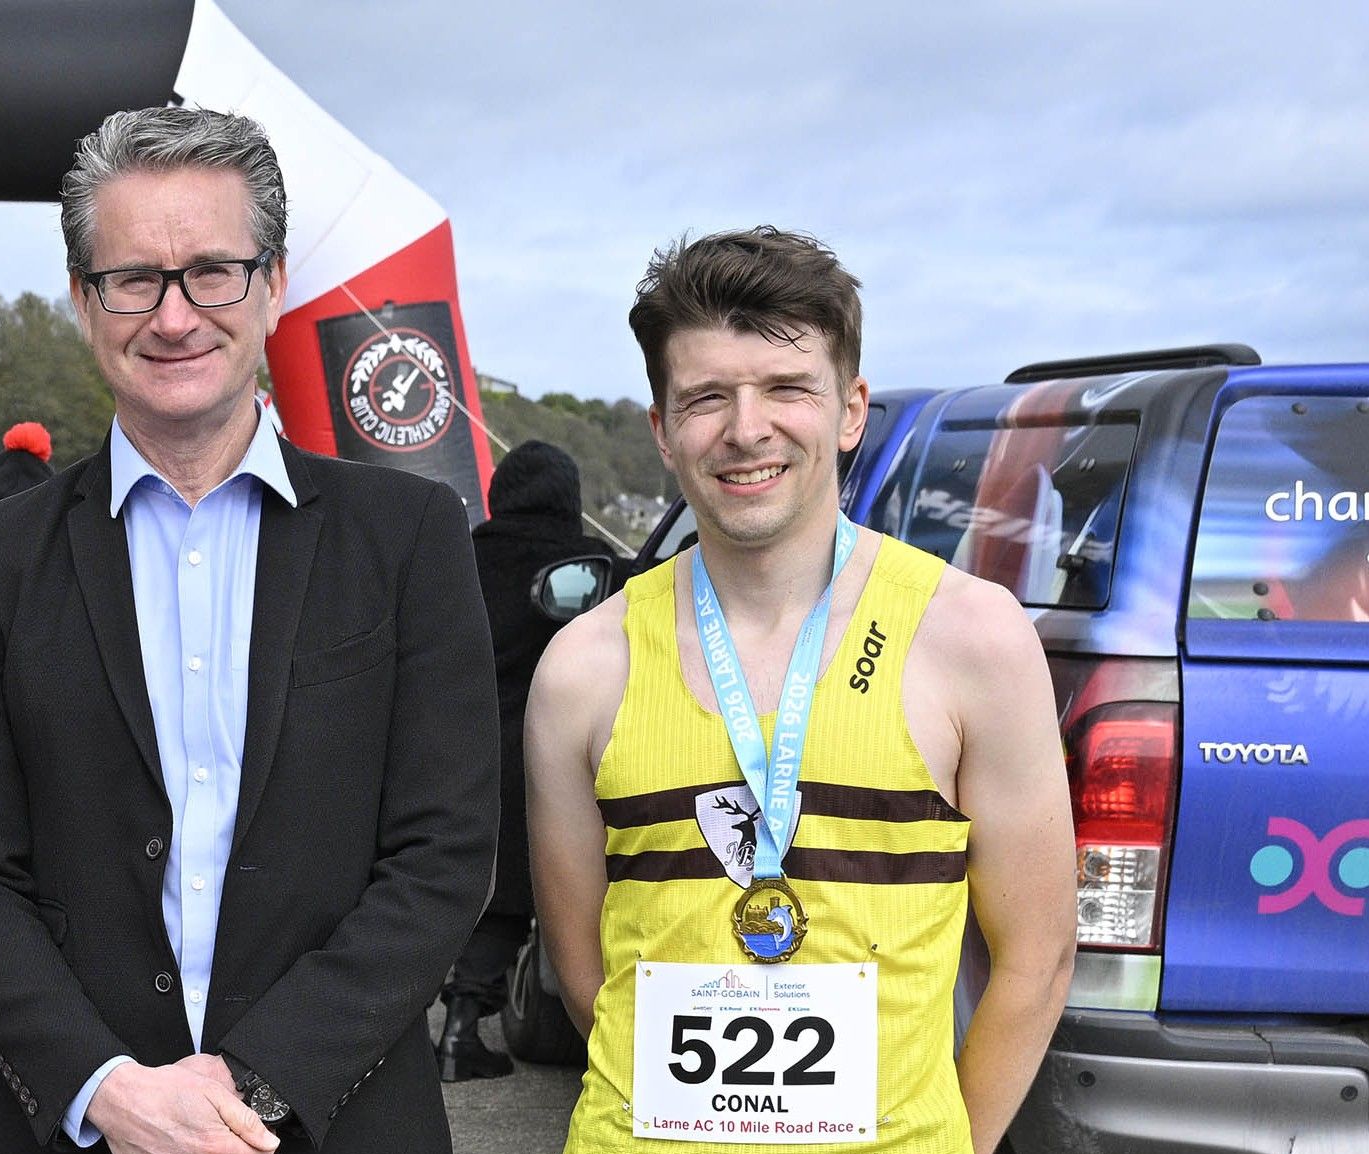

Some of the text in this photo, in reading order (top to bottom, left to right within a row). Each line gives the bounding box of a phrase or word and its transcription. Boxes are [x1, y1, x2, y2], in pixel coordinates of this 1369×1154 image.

[350, 381, 451, 445] LARNE ATHLETIC CLUB
[697, 588, 757, 743] 2026 LARNE AC
[849, 620, 887, 695] soar
[782, 671, 810, 725] 2026
[769, 732, 799, 811] LARNE
[1199, 741, 1309, 765] TOYOTA
[691, 988, 760, 998] SAINT-GOBAIN
[773, 981, 806, 991] Exterior
[774, 989, 810, 999] Solutions
[668, 1014, 836, 1085] 522
[711, 1094, 789, 1113] CONAL
[653, 1116, 854, 1134] Larne AC 10 Mile Road Race
